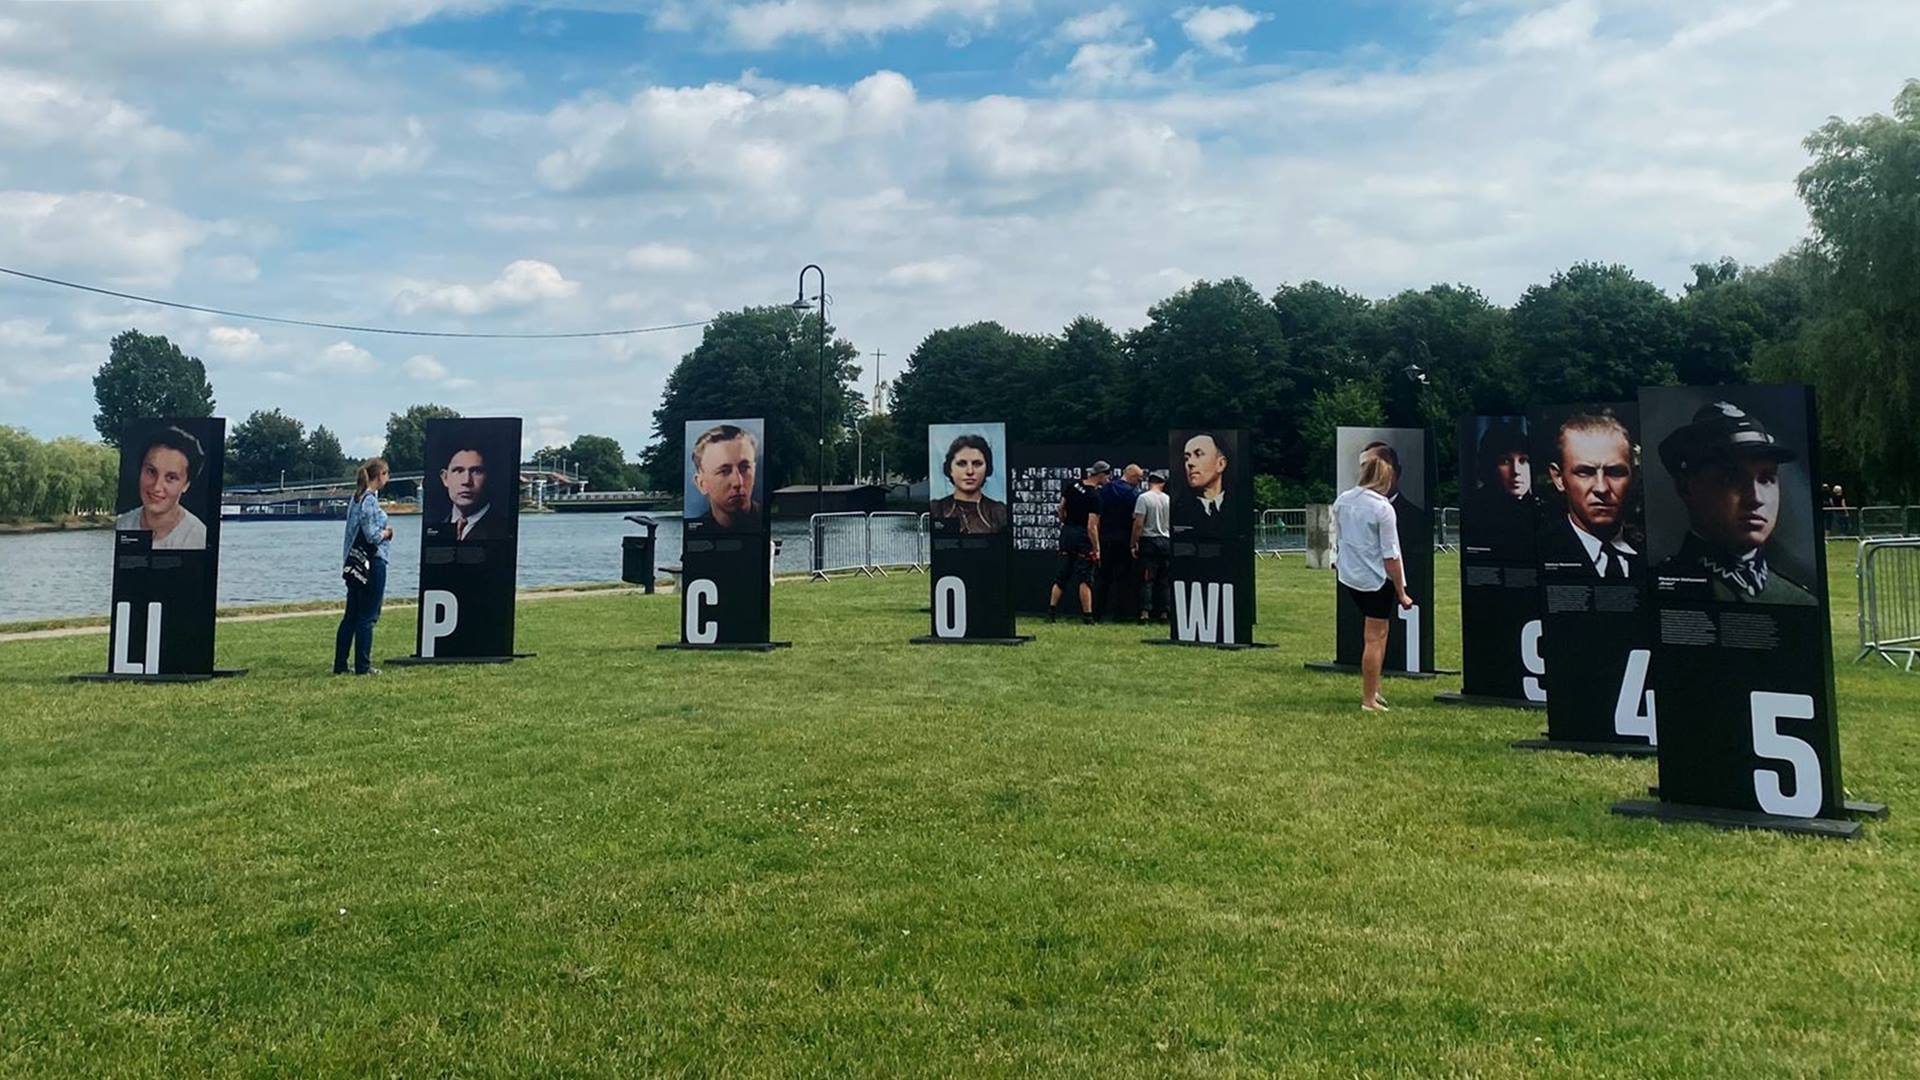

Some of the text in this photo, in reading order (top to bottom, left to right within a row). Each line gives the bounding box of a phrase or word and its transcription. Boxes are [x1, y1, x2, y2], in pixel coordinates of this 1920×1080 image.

[113, 602, 162, 674] LI
[421, 590, 458, 658] P
[686, 578, 718, 644] C
[935, 576, 967, 638] O
[1174, 580, 1234, 644] WI
[1398, 604, 1420, 673] 1
[1614, 649, 1658, 746] 4
[1750, 691, 1823, 818] 5
